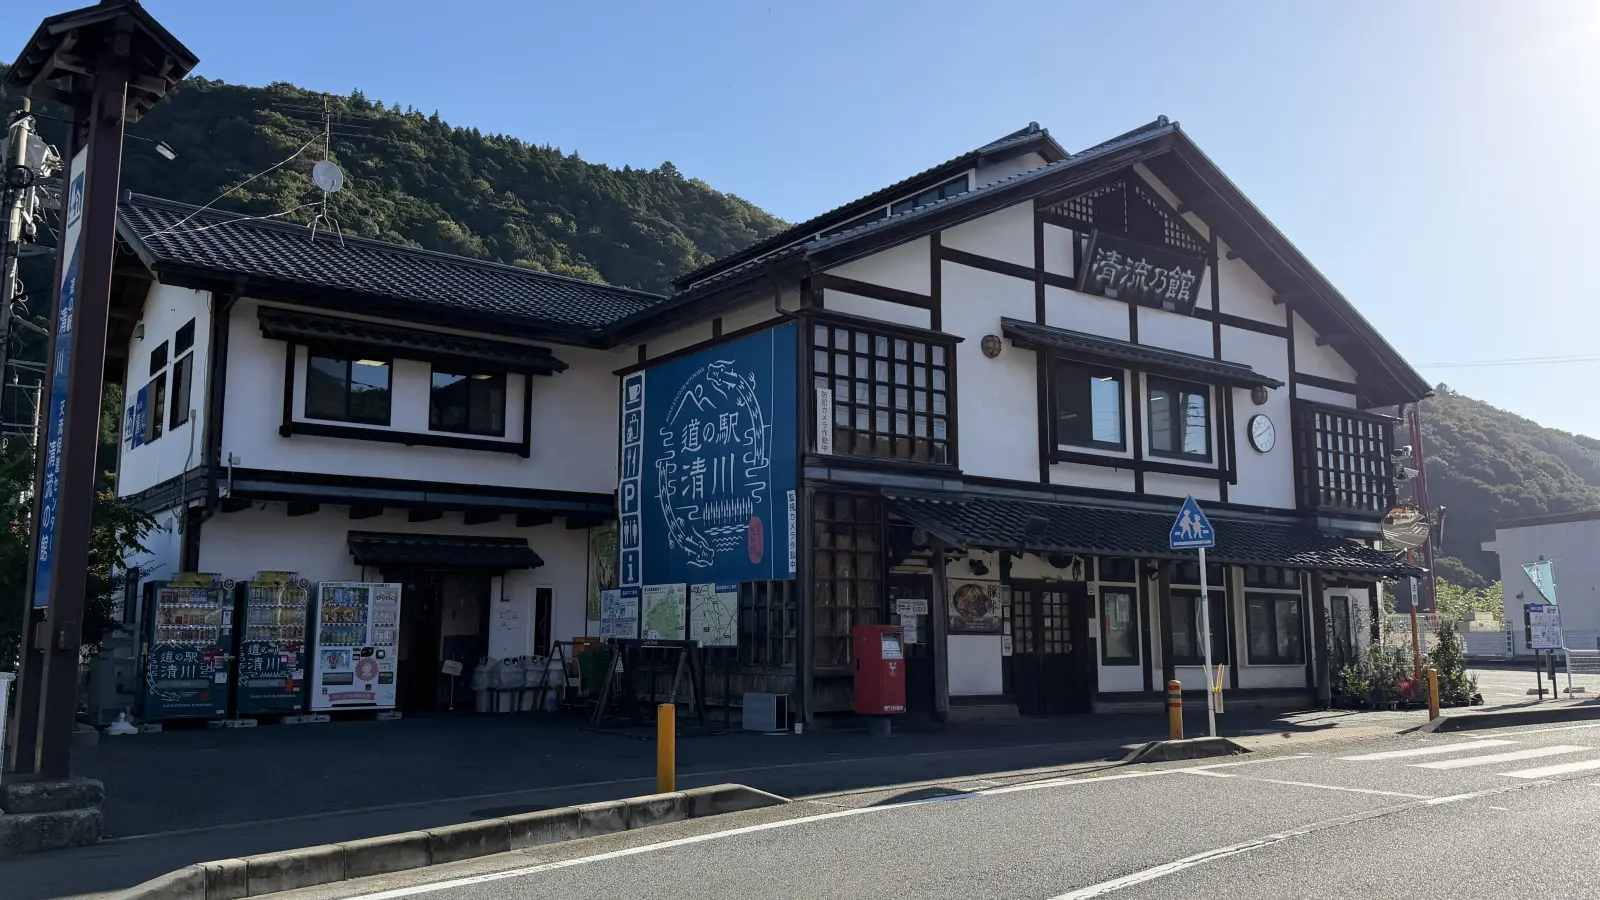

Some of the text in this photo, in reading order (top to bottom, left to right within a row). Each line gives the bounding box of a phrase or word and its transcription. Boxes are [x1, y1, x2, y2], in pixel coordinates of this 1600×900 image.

[1091, 247, 1197, 302] 清流乃館
[680, 411, 741, 454] 道の駅
[680, 452, 735, 500] 清川
[624, 483, 635, 511] P
[160, 650, 199, 663] 道の駅
[247, 656, 281, 671] 清川
[160, 663, 196, 679] 清川
